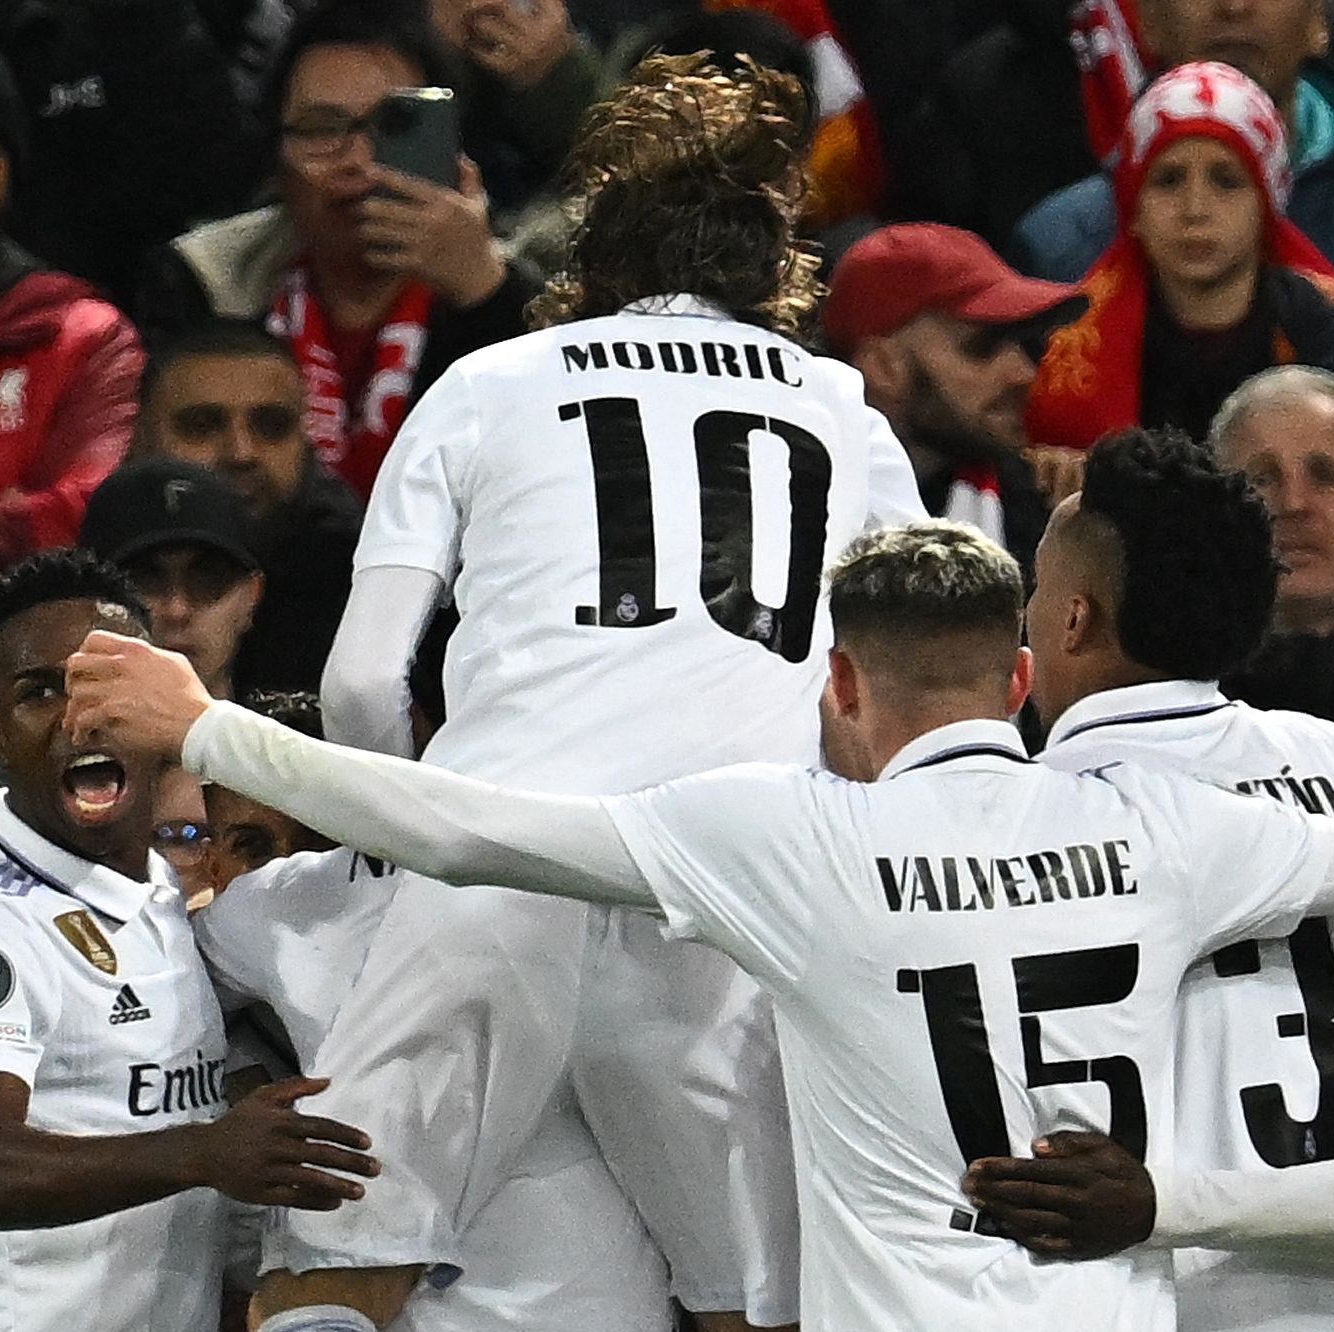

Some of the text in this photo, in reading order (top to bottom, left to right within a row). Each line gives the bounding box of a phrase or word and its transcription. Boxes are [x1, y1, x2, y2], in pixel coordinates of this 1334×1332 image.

[560, 341, 803, 388] MODRIC
[557, 396, 833, 664] 10
[875, 839, 1139, 914] VALVERDE
[128, 1048, 227, 1116] Emir
[895, 942, 1149, 1233] 15
